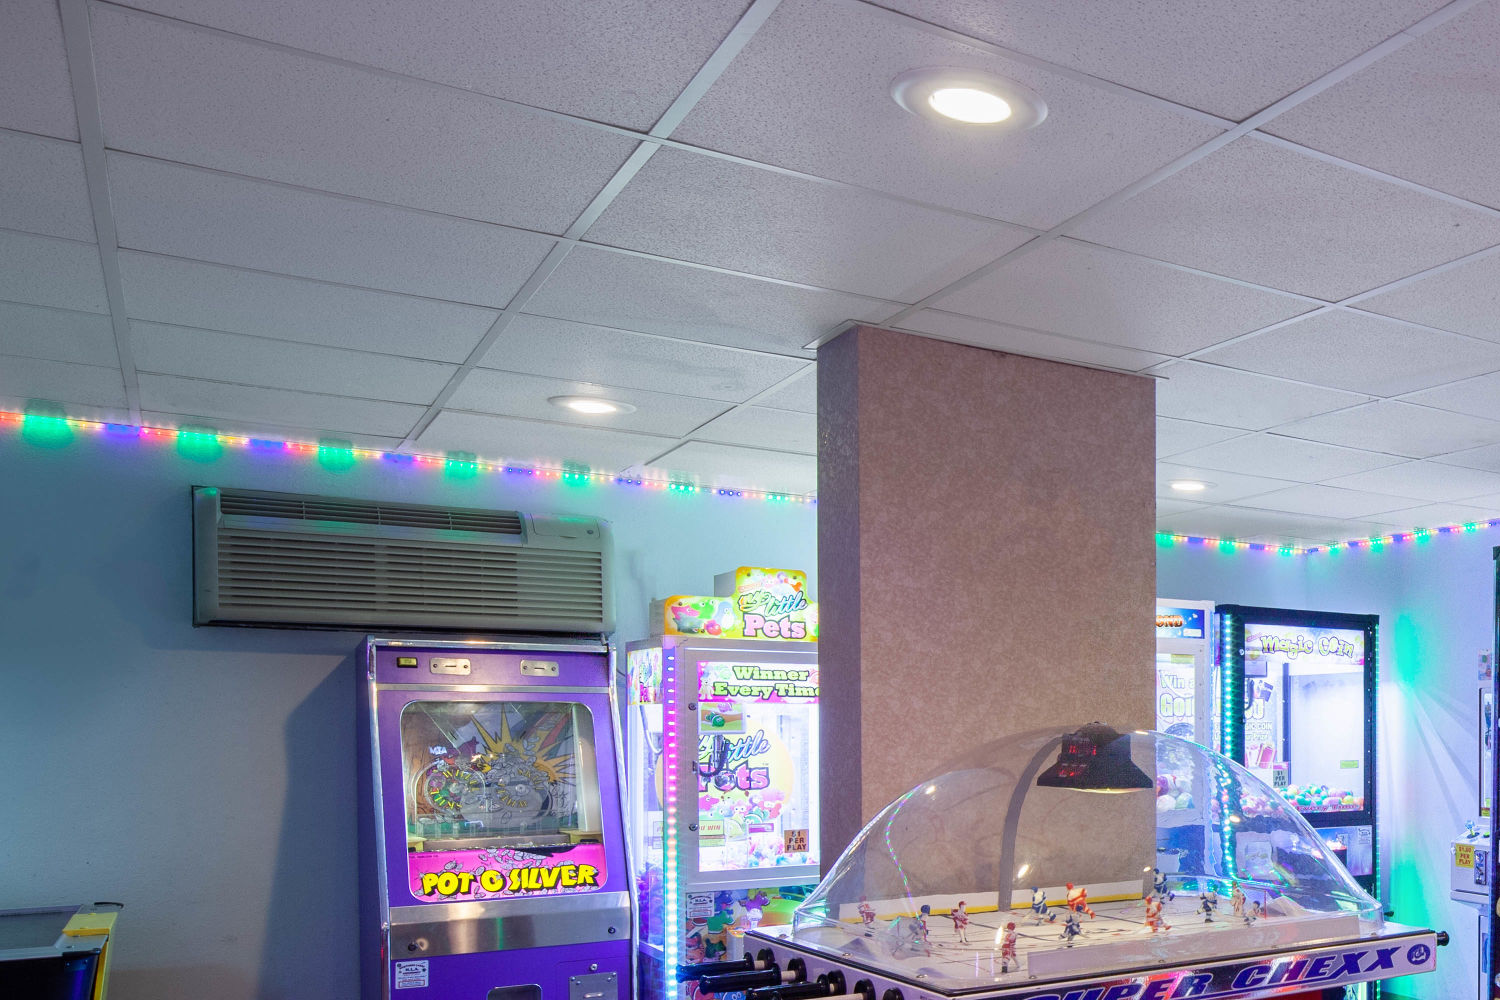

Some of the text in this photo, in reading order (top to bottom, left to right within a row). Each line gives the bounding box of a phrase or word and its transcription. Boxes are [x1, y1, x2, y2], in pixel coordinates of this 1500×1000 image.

[743, 612, 807, 639] Pets
[732, 666, 809, 682] Winner
[713, 681, 775, 700] Every
[422, 872, 475, 896] POT
[509, 865, 597, 891] SILVER
[1231, 946, 1400, 995] CHEXX
